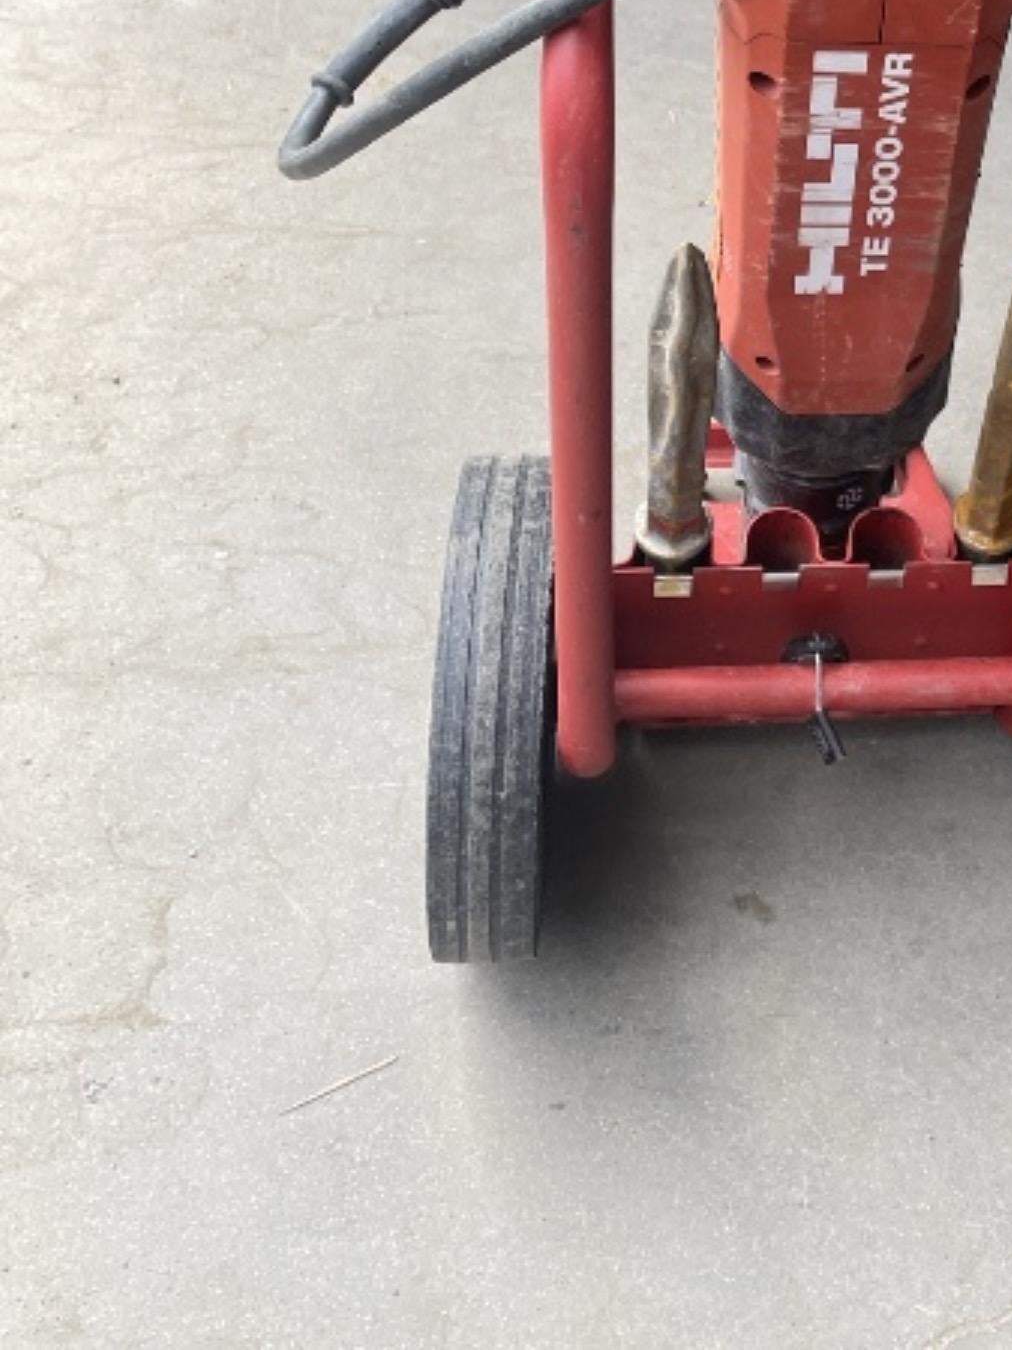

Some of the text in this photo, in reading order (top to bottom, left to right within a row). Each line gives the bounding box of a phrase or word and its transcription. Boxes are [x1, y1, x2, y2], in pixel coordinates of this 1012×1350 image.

[794, 50, 868, 295] HILTI
[860, 52, 914, 277] TE 3000-AVR
